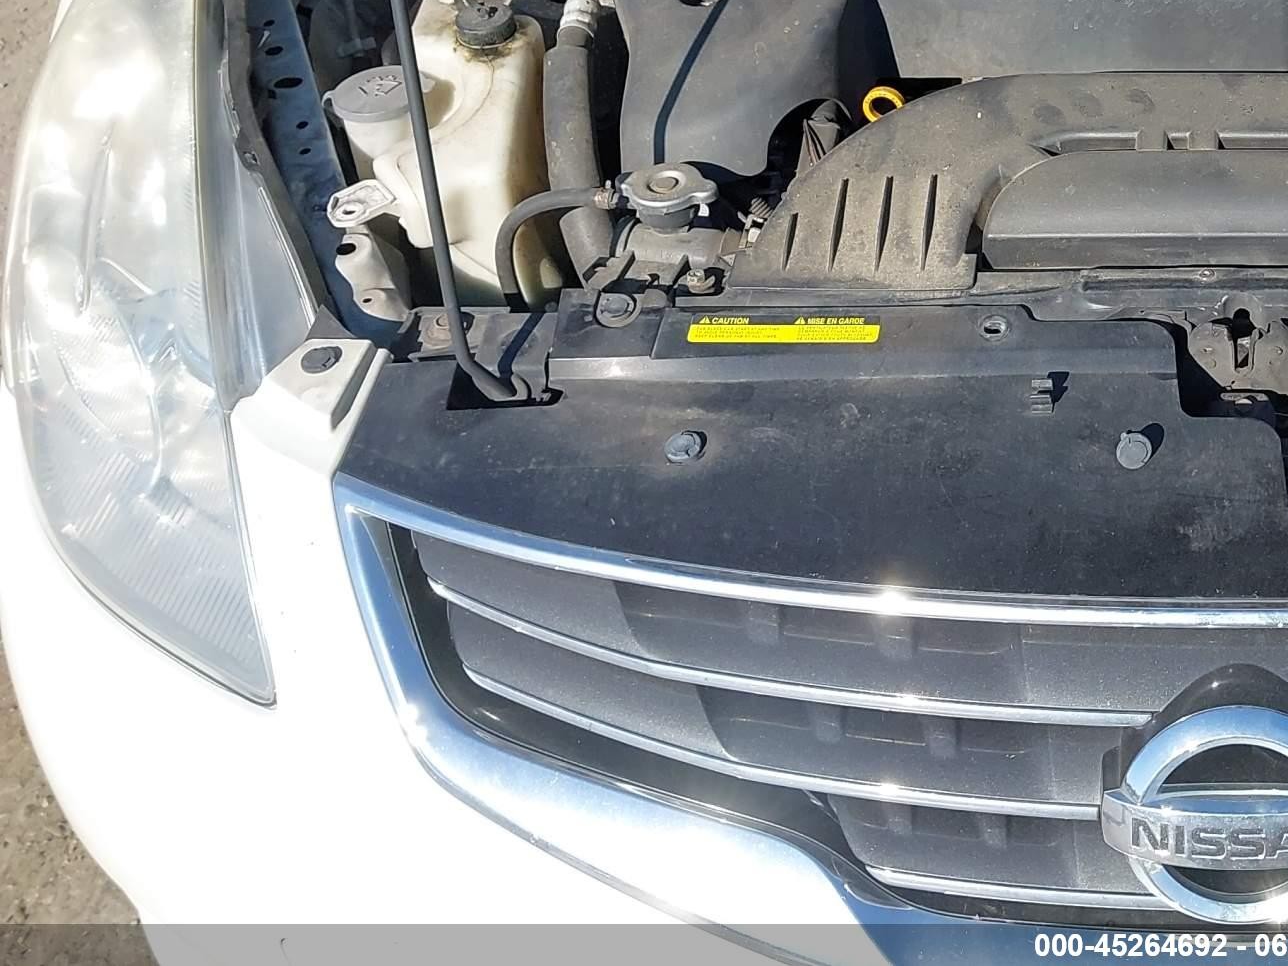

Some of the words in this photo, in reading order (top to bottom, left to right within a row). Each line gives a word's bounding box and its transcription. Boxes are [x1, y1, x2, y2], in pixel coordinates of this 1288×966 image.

[711, 317, 750, 325] CAUTION
[807, 317, 826, 325] MISE
[826, 317, 838, 325] EN
[838, 317, 865, 325] GARDE
